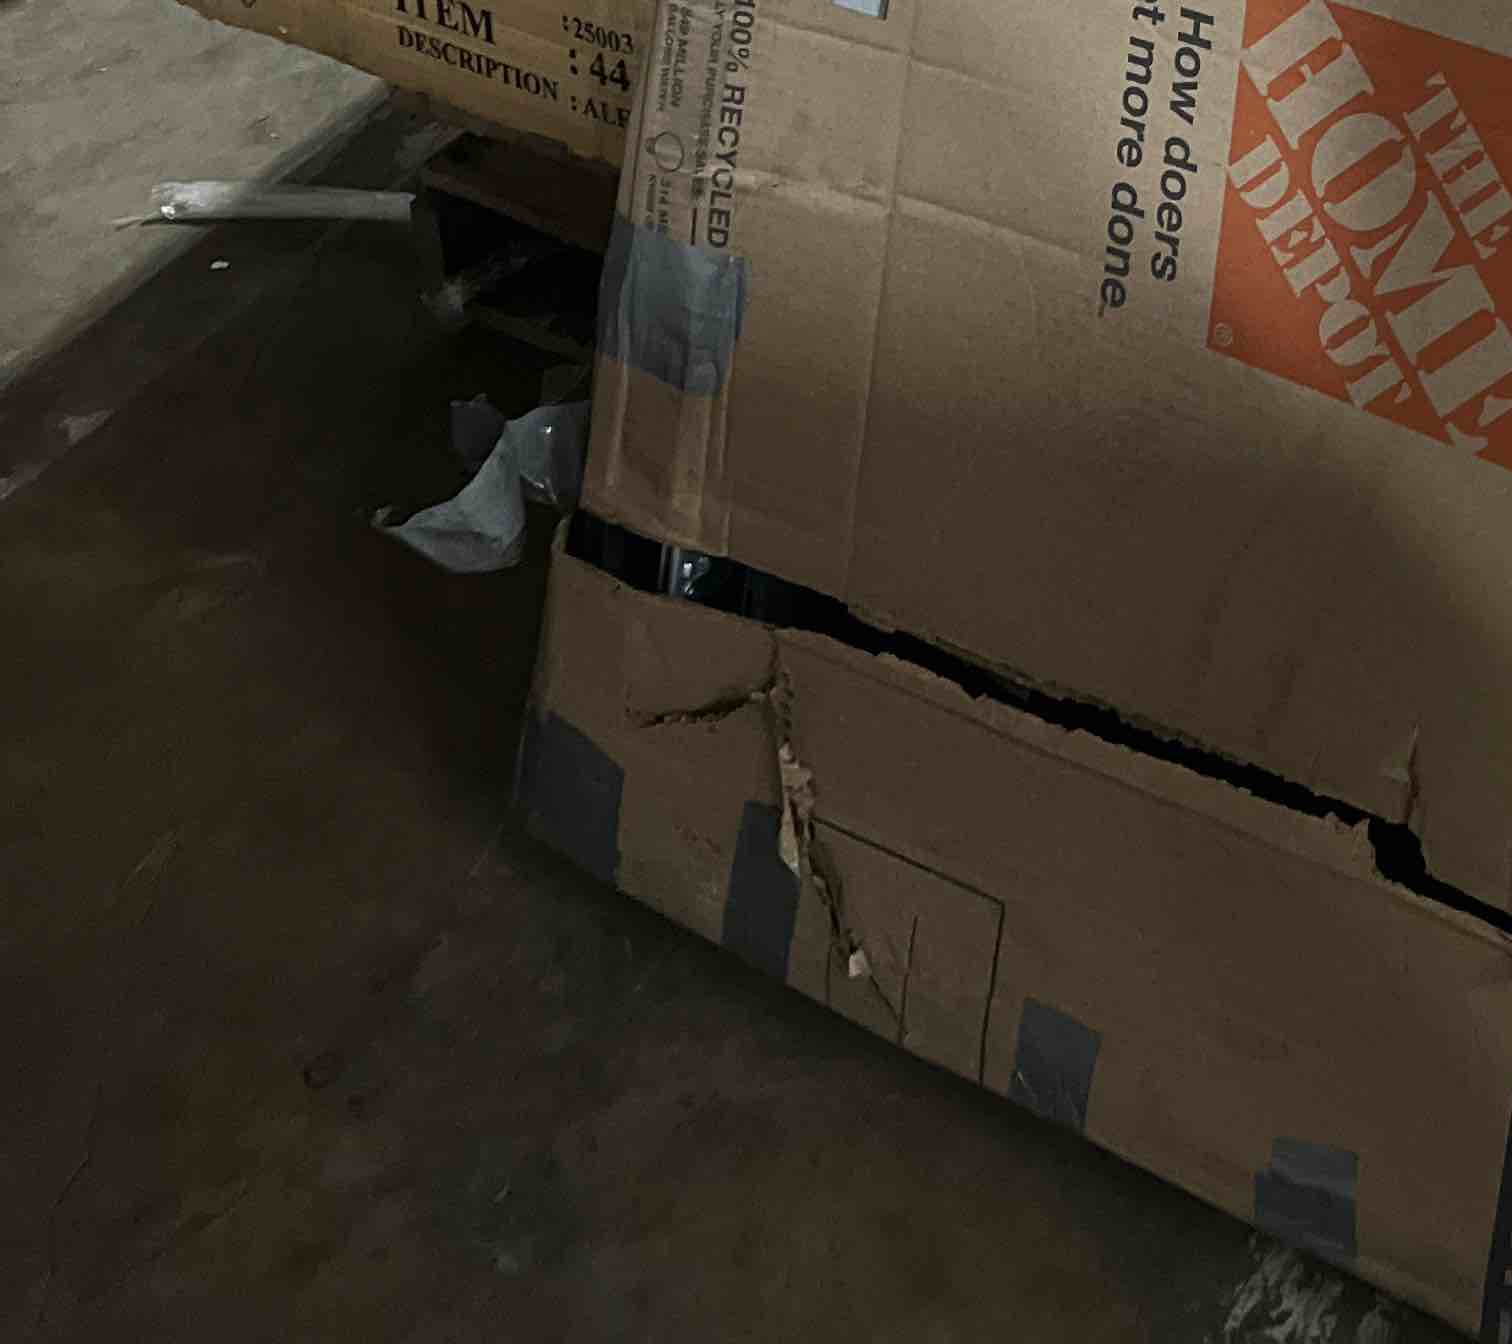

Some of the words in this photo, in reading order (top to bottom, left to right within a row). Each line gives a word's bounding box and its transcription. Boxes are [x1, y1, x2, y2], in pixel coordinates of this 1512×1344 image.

[397, 26, 560, 101] DESCRIPTION
[1116, 34, 1156, 170] more
[1169, 7, 1214, 125] How
[705, 83, 746, 249] RECYCLED
[1151, 127, 1197, 283] doers
[1227, 133, 1412, 411] DEPOT
